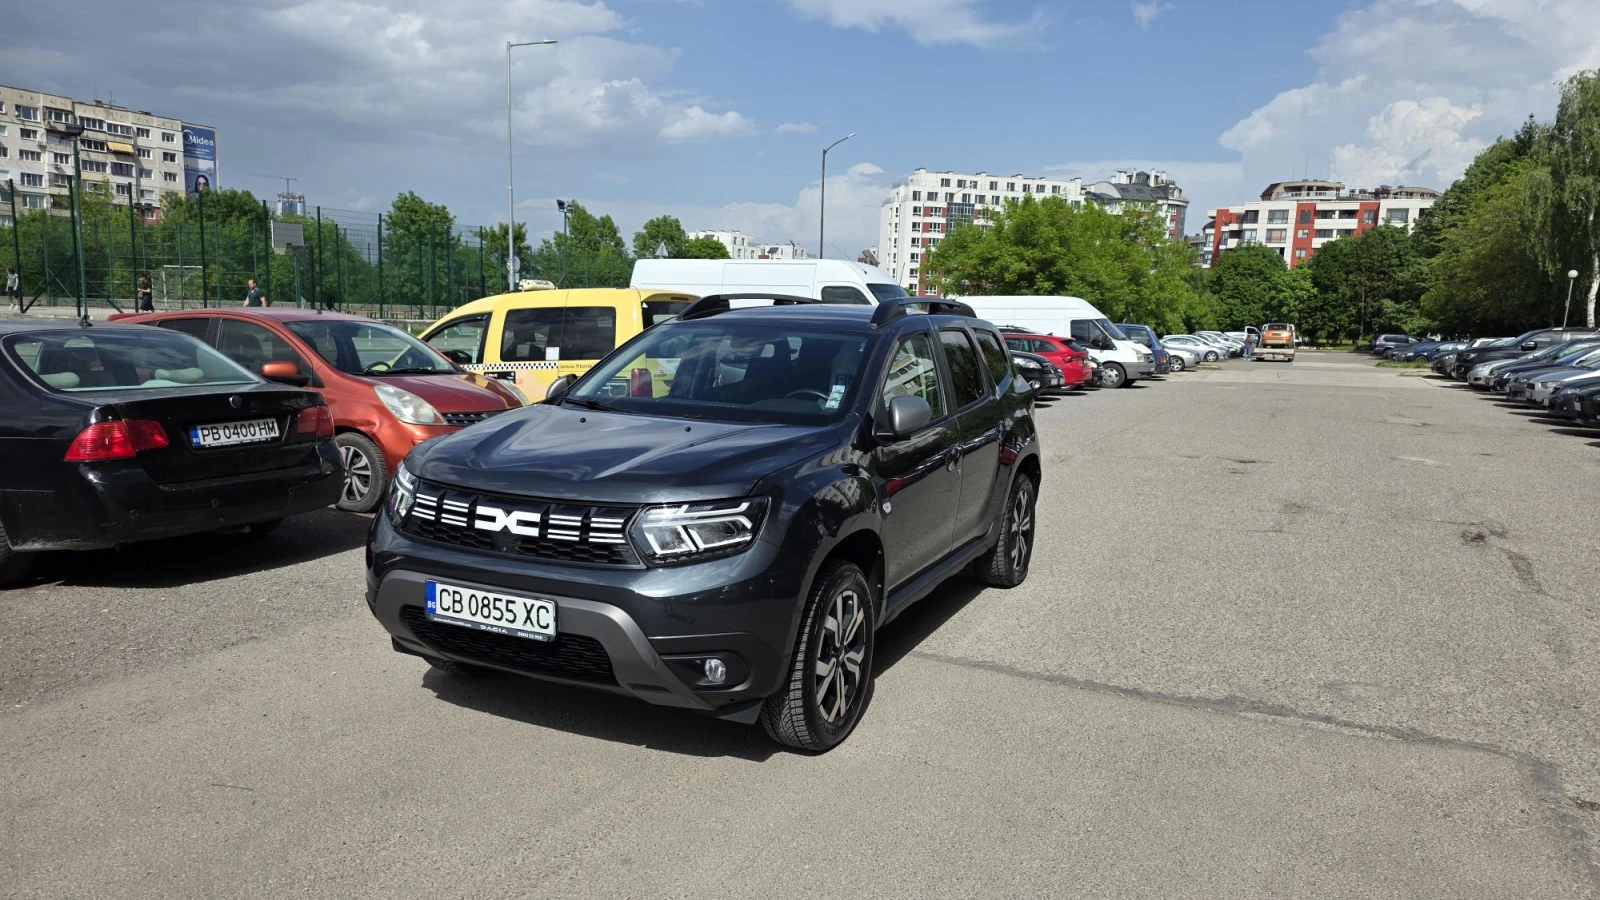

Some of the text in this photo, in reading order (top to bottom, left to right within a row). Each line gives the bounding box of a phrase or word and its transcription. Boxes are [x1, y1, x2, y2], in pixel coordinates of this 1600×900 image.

[189, 134, 214, 146] Midea
[201, 426, 221, 442] PB
[223, 422, 256, 440] 0400
[258, 420, 277, 436] HM
[427, 600, 436, 608] BG
[439, 588, 550, 630] CB 0855 XC
[480, 624, 508, 634] DACIA
